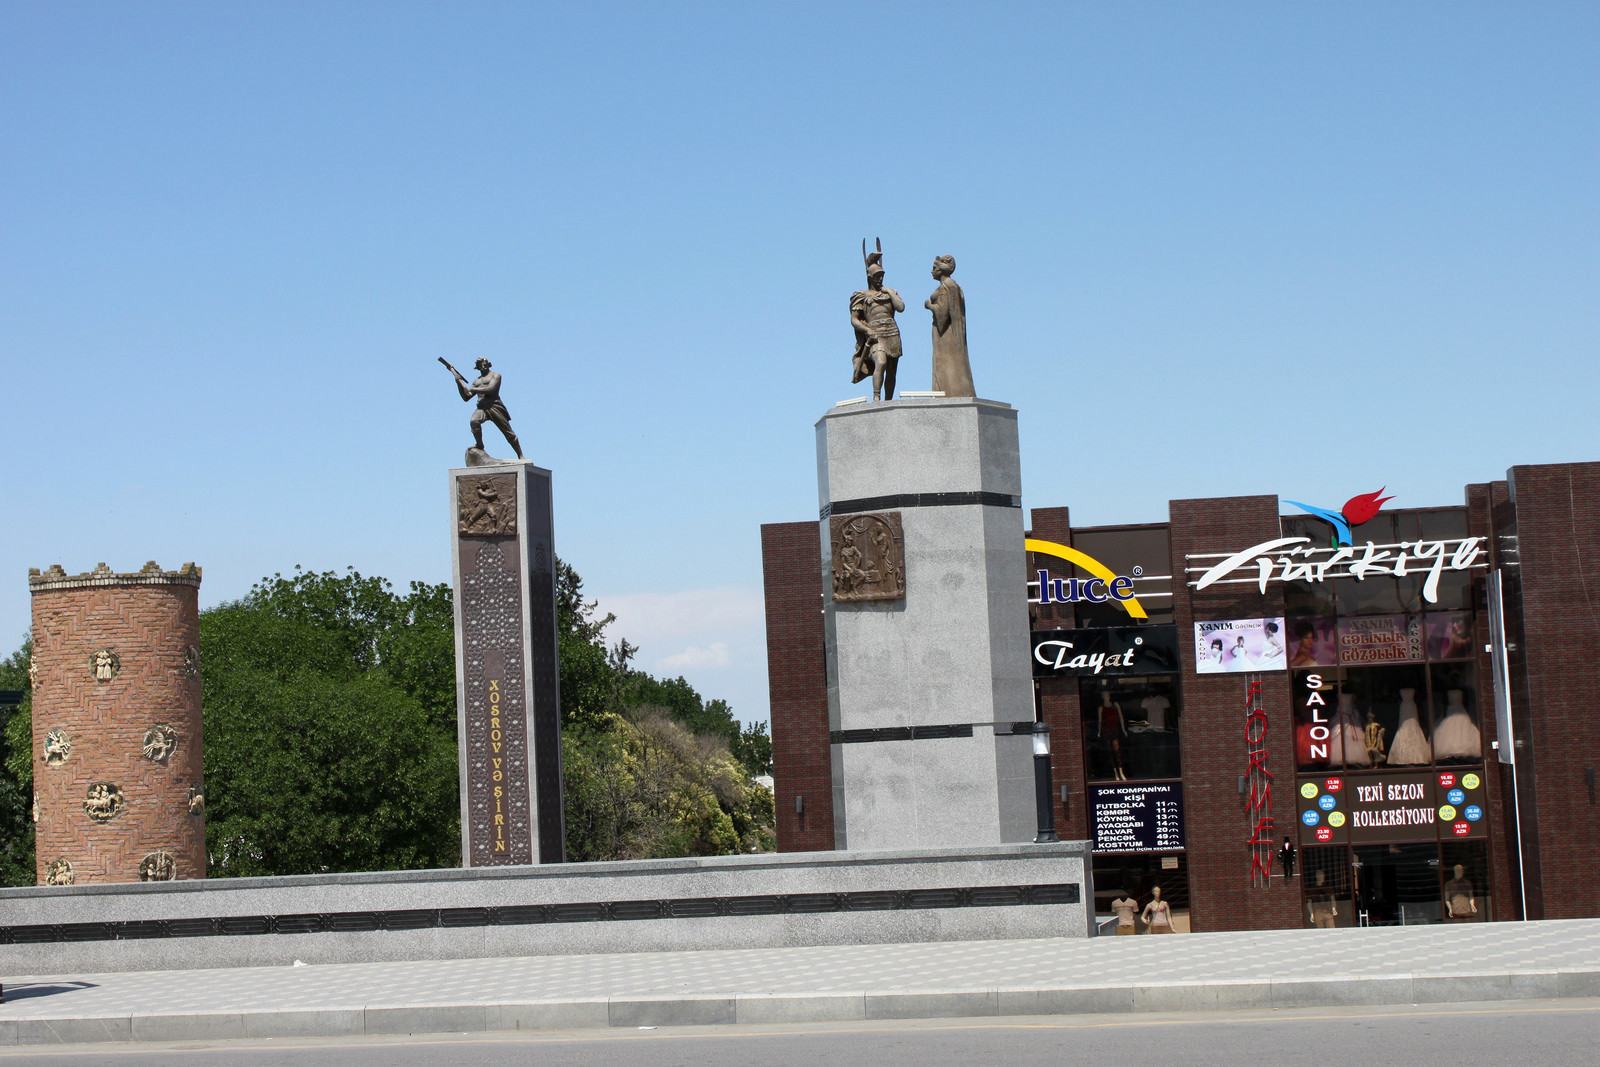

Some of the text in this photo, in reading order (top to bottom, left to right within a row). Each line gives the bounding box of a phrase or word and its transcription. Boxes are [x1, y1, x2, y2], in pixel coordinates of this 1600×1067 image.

[1196, 537, 1481, 604] Türkiye
[1198, 622, 1233, 631] XANIM
[1351, 618, 1394, 631] XANIM
[1341, 631, 1405, 645] GƏLİNLİK
[1034, 640, 1135, 675] Tayat
[1341, 645, 1407, 662] GÖZƏLLİK
[1306, 674, 1330, 759] SALON
[489, 679, 506, 852] XOSROV VƏ ŞİRİN
[1097, 785, 1171, 796] ŞOK KOMPANİYA!
[1356, 782, 1424, 802] YENİ SEZON
[1124, 794, 1145, 802] KİŞİ
[1096, 802, 1146, 810] FUTBOLKA
[1096, 815, 1136, 823] KÖYNƏK
[1096, 821, 1144, 829] AYAQQABI
[1097, 829, 1133, 837] ŞALVAR
[1098, 841, 1143, 849] KOSTYUM
